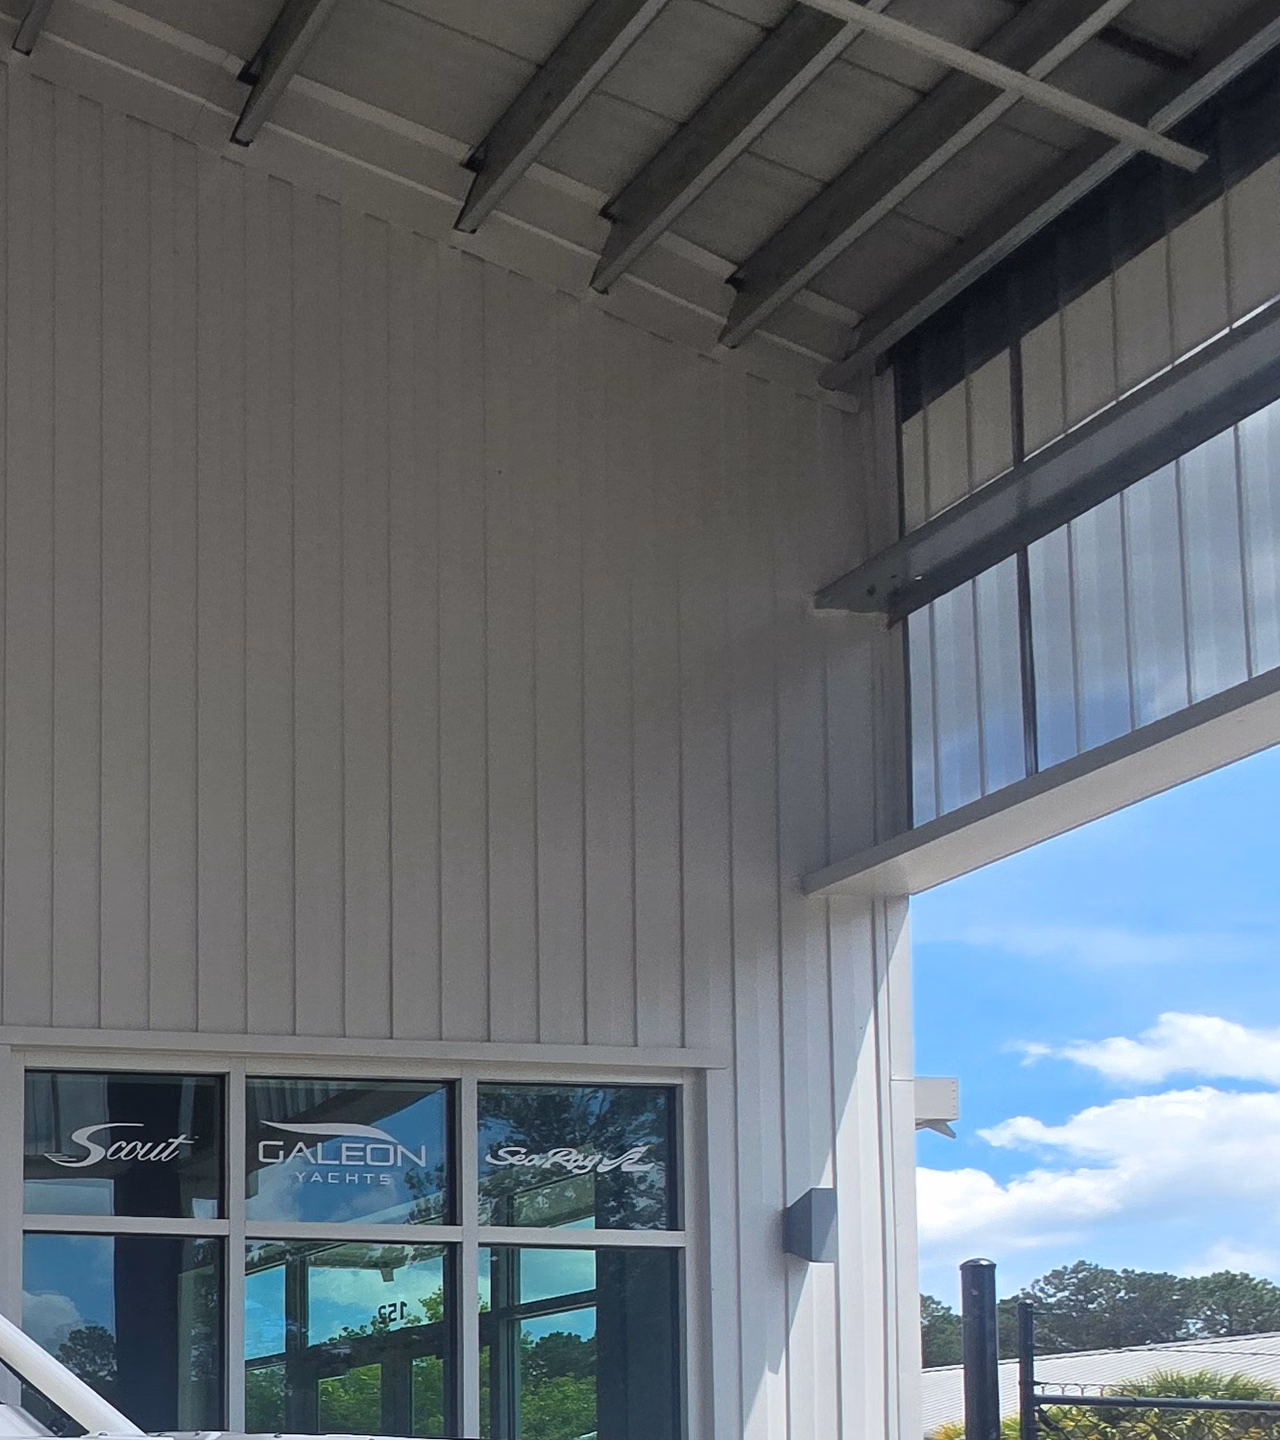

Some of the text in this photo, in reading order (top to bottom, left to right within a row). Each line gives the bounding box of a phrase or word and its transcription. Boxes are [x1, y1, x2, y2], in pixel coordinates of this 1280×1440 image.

[44, 1123, 195, 1168] Scout
[258, 1141, 426, 1168] GALEON
[485, 1147, 601, 1174] Sea Ray
[295, 1171, 393, 1185] YACHTS
